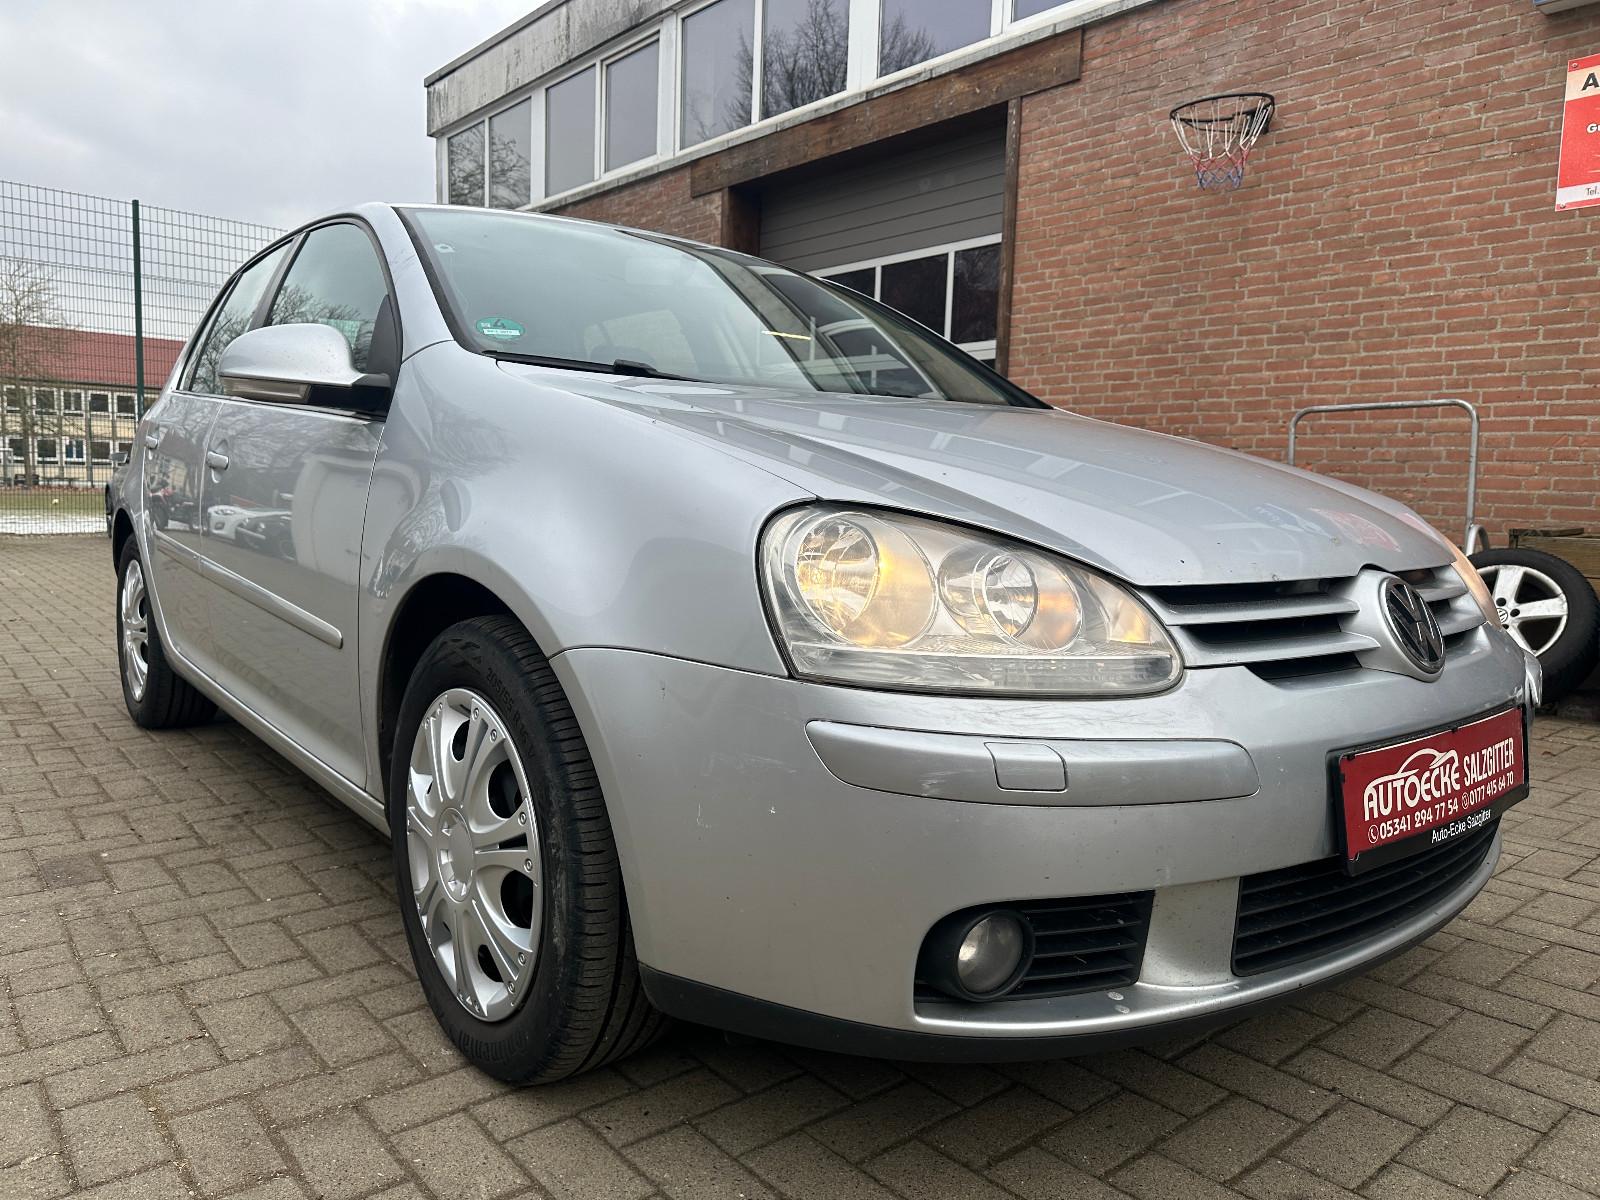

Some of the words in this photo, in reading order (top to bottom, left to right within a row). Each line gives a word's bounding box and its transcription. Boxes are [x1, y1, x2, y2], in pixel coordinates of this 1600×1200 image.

[1363, 752, 1461, 821] AUTOECKE
[1463, 737, 1514, 787] SALZGITTER
[1379, 814, 1411, 840] 05341
[1414, 807, 1433, 828] 294
[1434, 801, 1446, 820] 77
[1448, 797, 1459, 815] 54
[1469, 784, 1486, 806] 0177
[1486, 778, 1497, 797] 415
[1498, 774, 1506, 792] 64
[1506, 770, 1514, 786] 70
[1431, 820, 1467, 844] Auto-Ecke
[1466, 808, 1491, 828] Salzgitter
